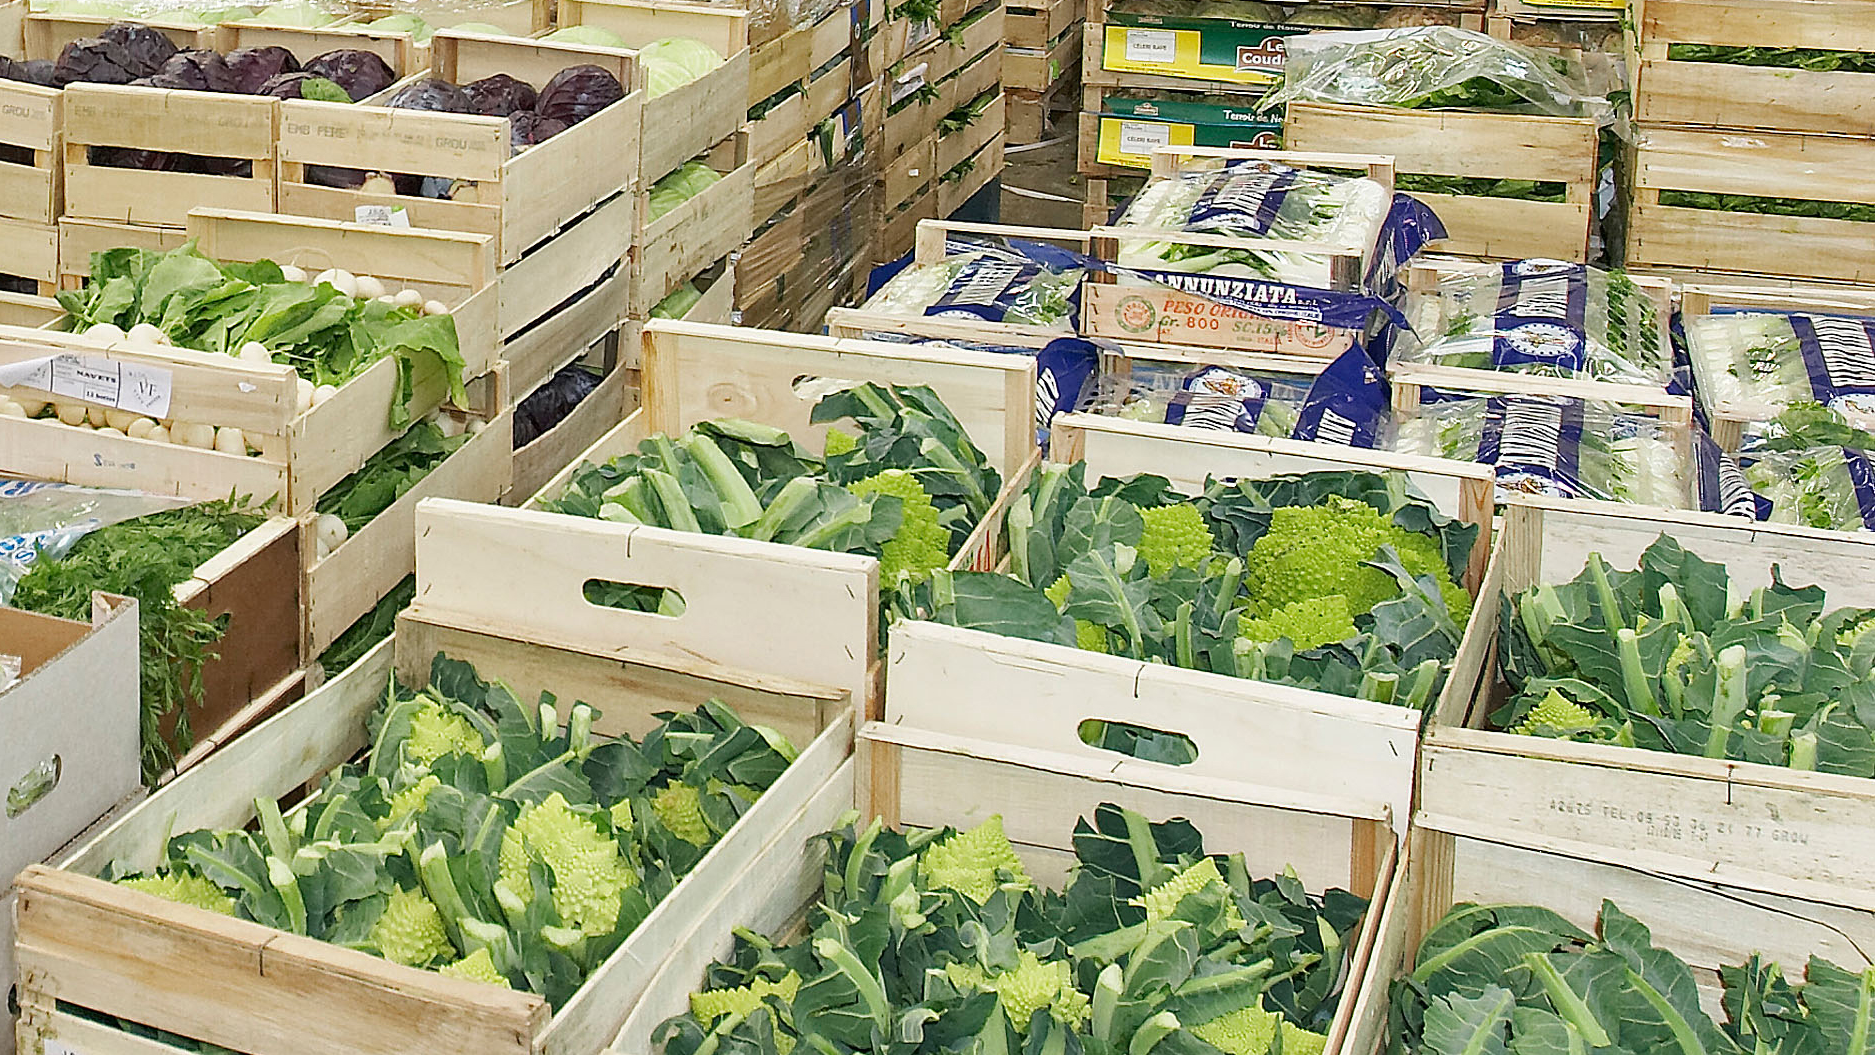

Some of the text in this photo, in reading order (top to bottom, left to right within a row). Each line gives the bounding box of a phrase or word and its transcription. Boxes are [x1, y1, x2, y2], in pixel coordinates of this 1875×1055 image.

[1267, 42, 1284, 52] Le
[1242, 52, 1284, 65] Coud
[1163, 300, 1205, 315] PESO
[1186, 317, 1219, 330] 800
[77, 369, 117, 384] NAVETS
